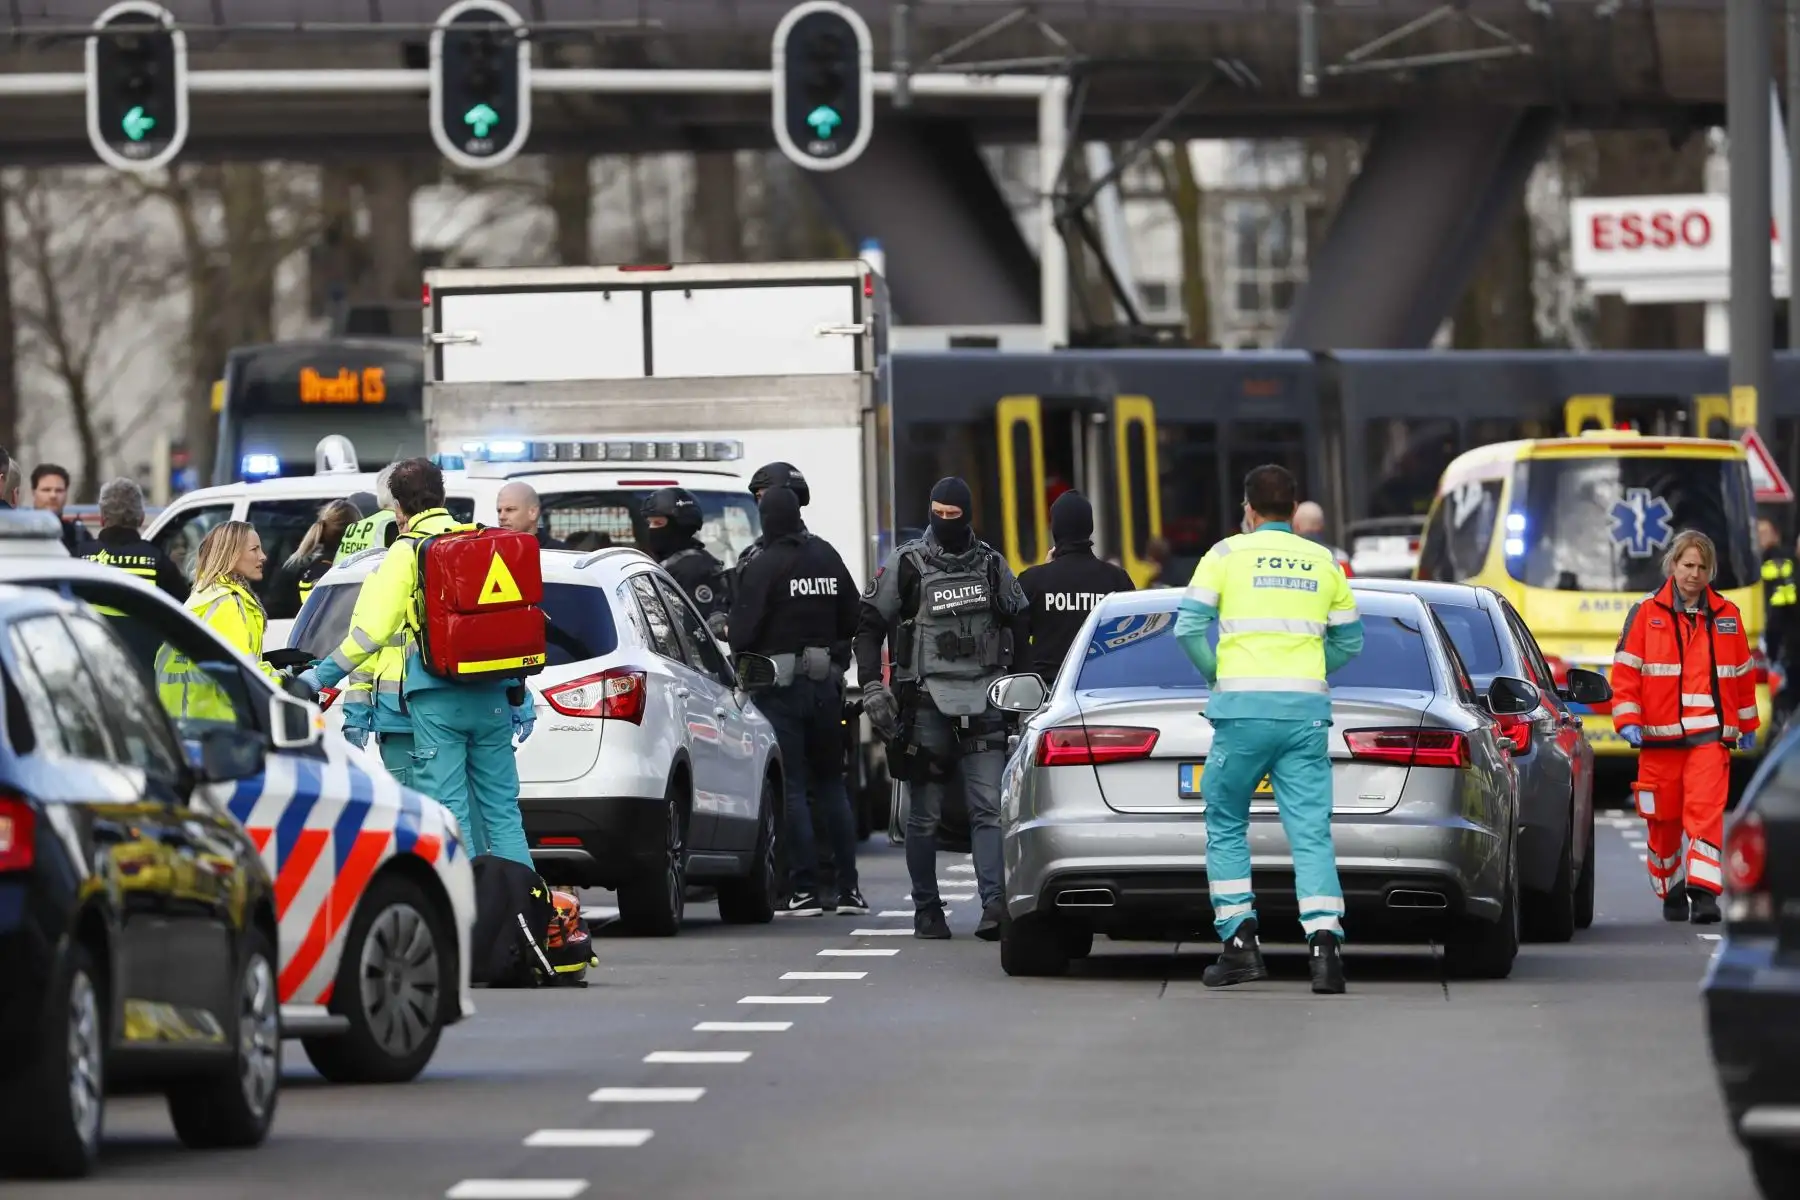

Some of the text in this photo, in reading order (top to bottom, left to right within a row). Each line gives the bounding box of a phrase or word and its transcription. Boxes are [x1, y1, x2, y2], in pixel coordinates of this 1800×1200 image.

[1591, 210, 1712, 251] ESSO
[790, 577, 838, 596] POLITIE
[933, 584, 983, 602] POLITIE
[522, 655, 539, 666] PAX
